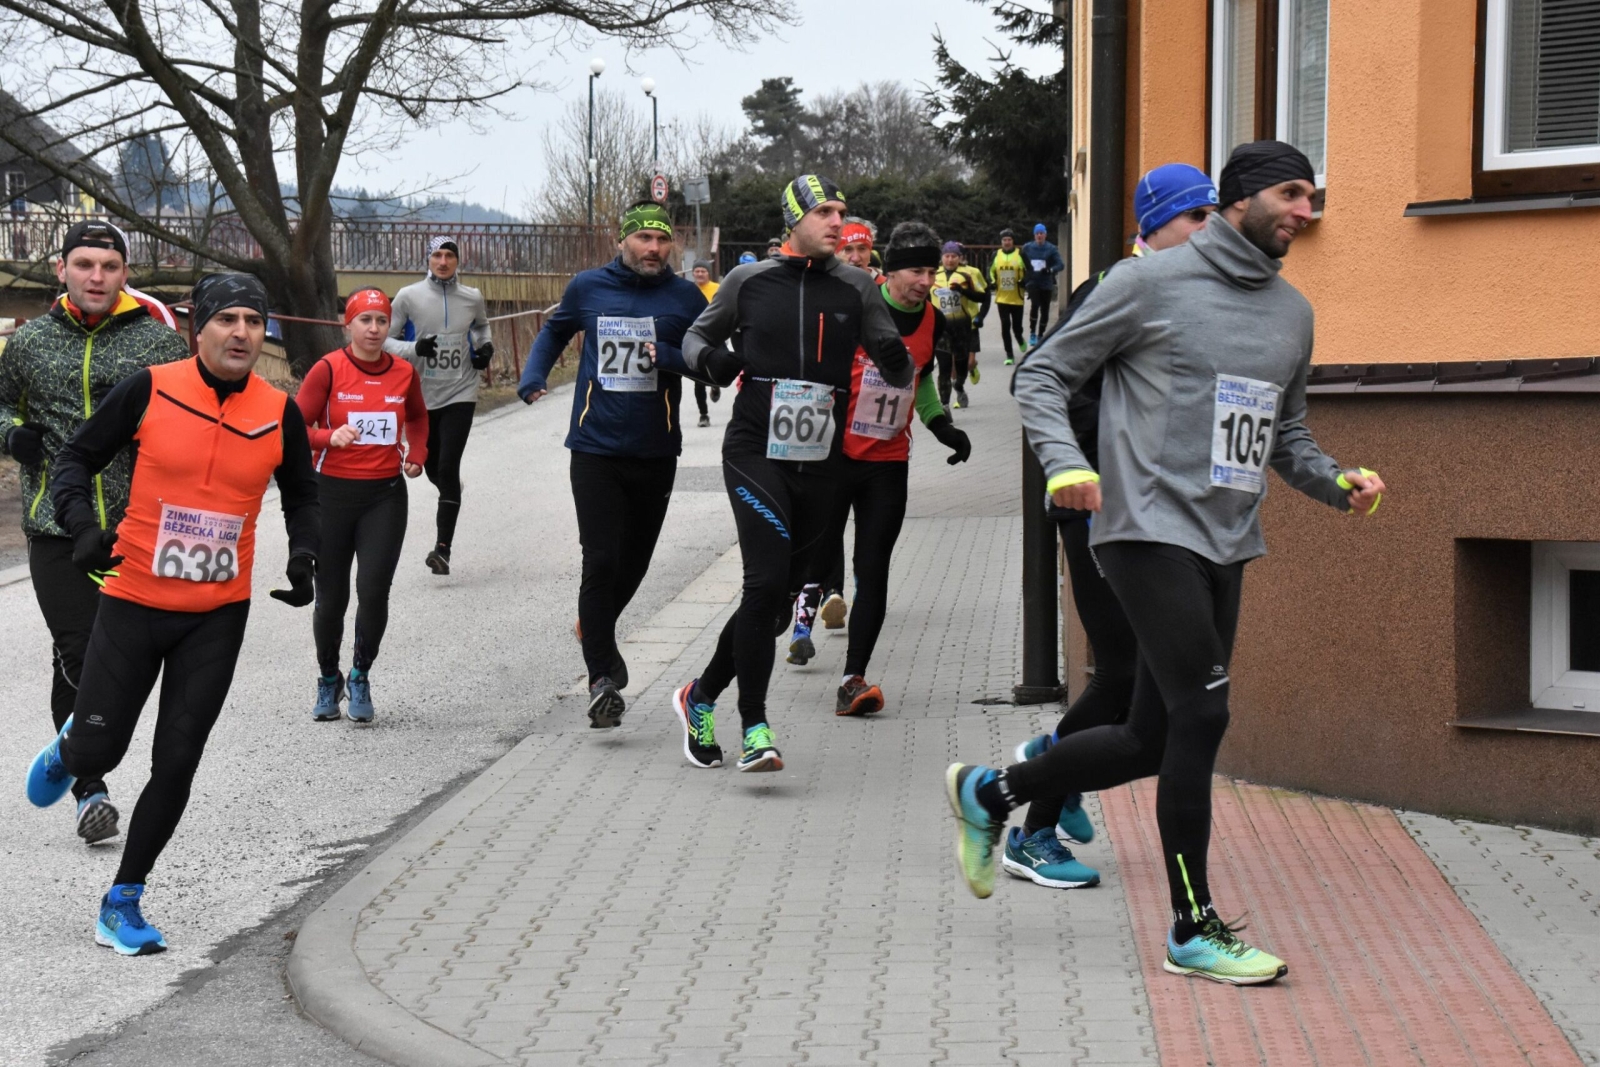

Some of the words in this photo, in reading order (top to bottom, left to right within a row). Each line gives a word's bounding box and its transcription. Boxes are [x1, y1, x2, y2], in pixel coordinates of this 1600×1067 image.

[1002, 276, 1016, 287] 653
[940, 294, 961, 309] 642
[598, 328, 632, 337] BĚŽECKÁ
[635, 329, 653, 337] LIGA
[600, 340, 655, 374] 275
[865, 370, 881, 378] ZIM
[874, 393, 900, 426] 11
[355, 418, 392, 440] 327
[773, 404, 831, 443] 667
[1220, 412, 1272, 468] 105
[166, 510, 202, 524] ZIMNÍ
[735, 486, 790, 541] DYNAFIT
[164, 521, 214, 538] BĚŽECKÁ
[218, 530, 238, 542] LIGA
[157, 538, 235, 583] 638
